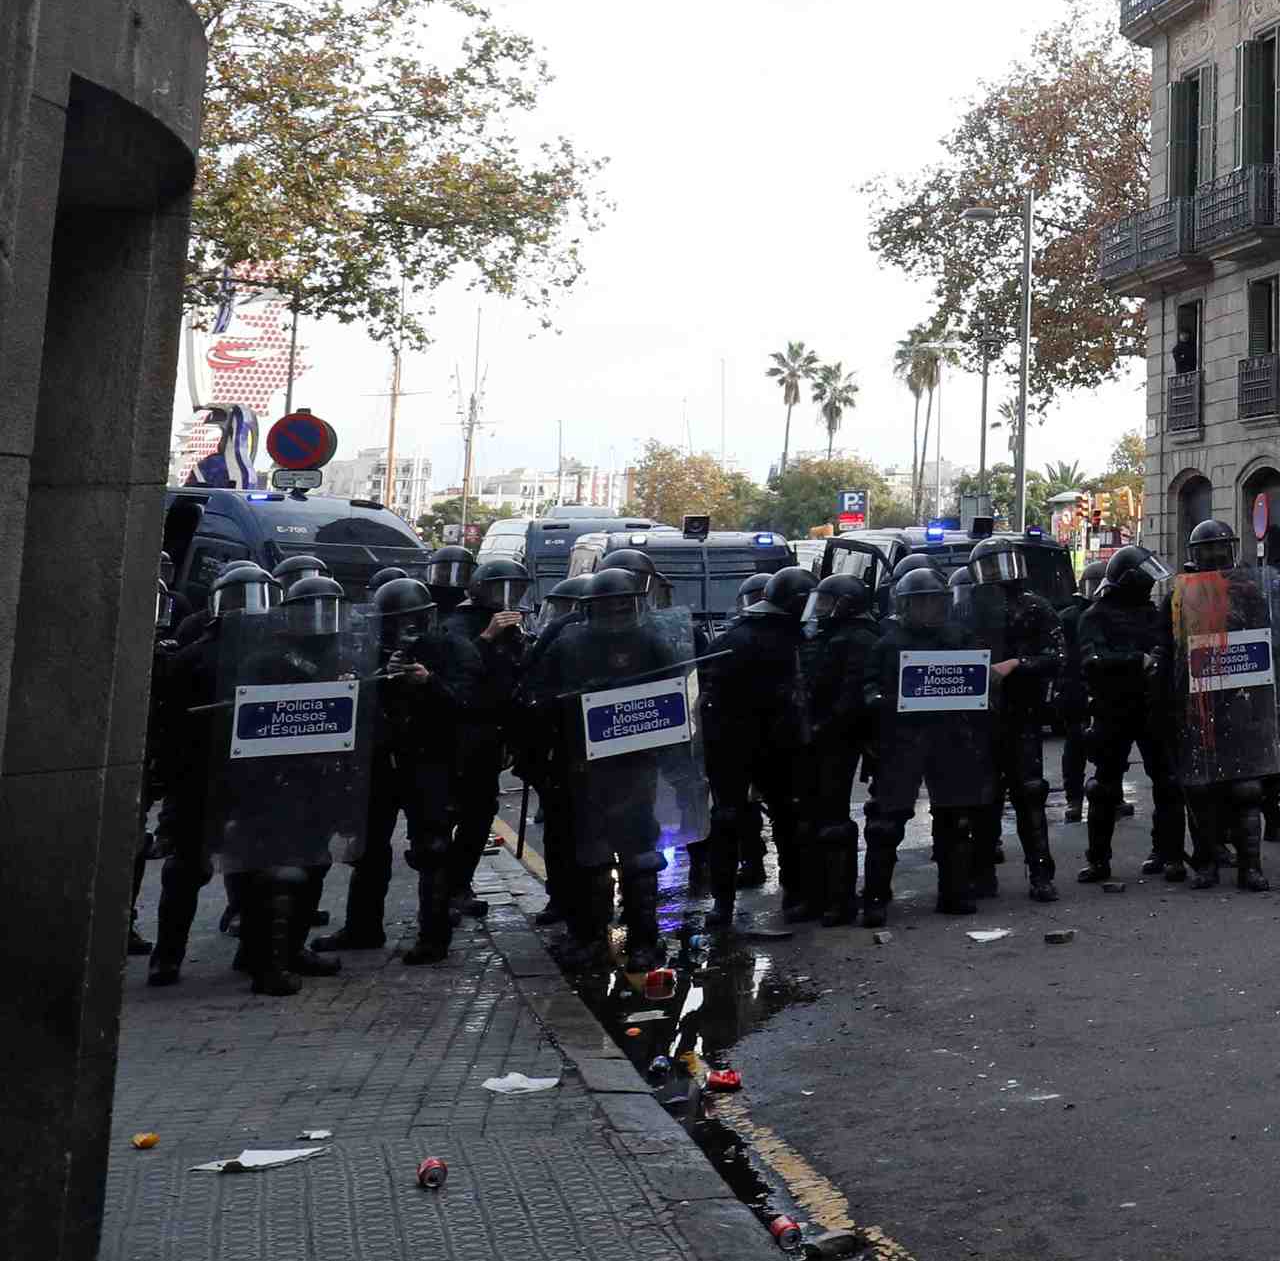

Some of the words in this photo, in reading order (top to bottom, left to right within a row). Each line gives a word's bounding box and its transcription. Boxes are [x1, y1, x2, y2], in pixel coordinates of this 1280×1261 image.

[927, 665, 963, 675] Policia
[924, 675, 966, 685] Mossos
[276, 700, 324, 712] Policia
[614, 699, 656, 713] Policia
[272, 710, 328, 723] Mossos
[613, 708, 660, 724] Mossos
[258, 721, 338, 736] d'Esquadra
[602, 718, 671, 738] d'Esquadra
